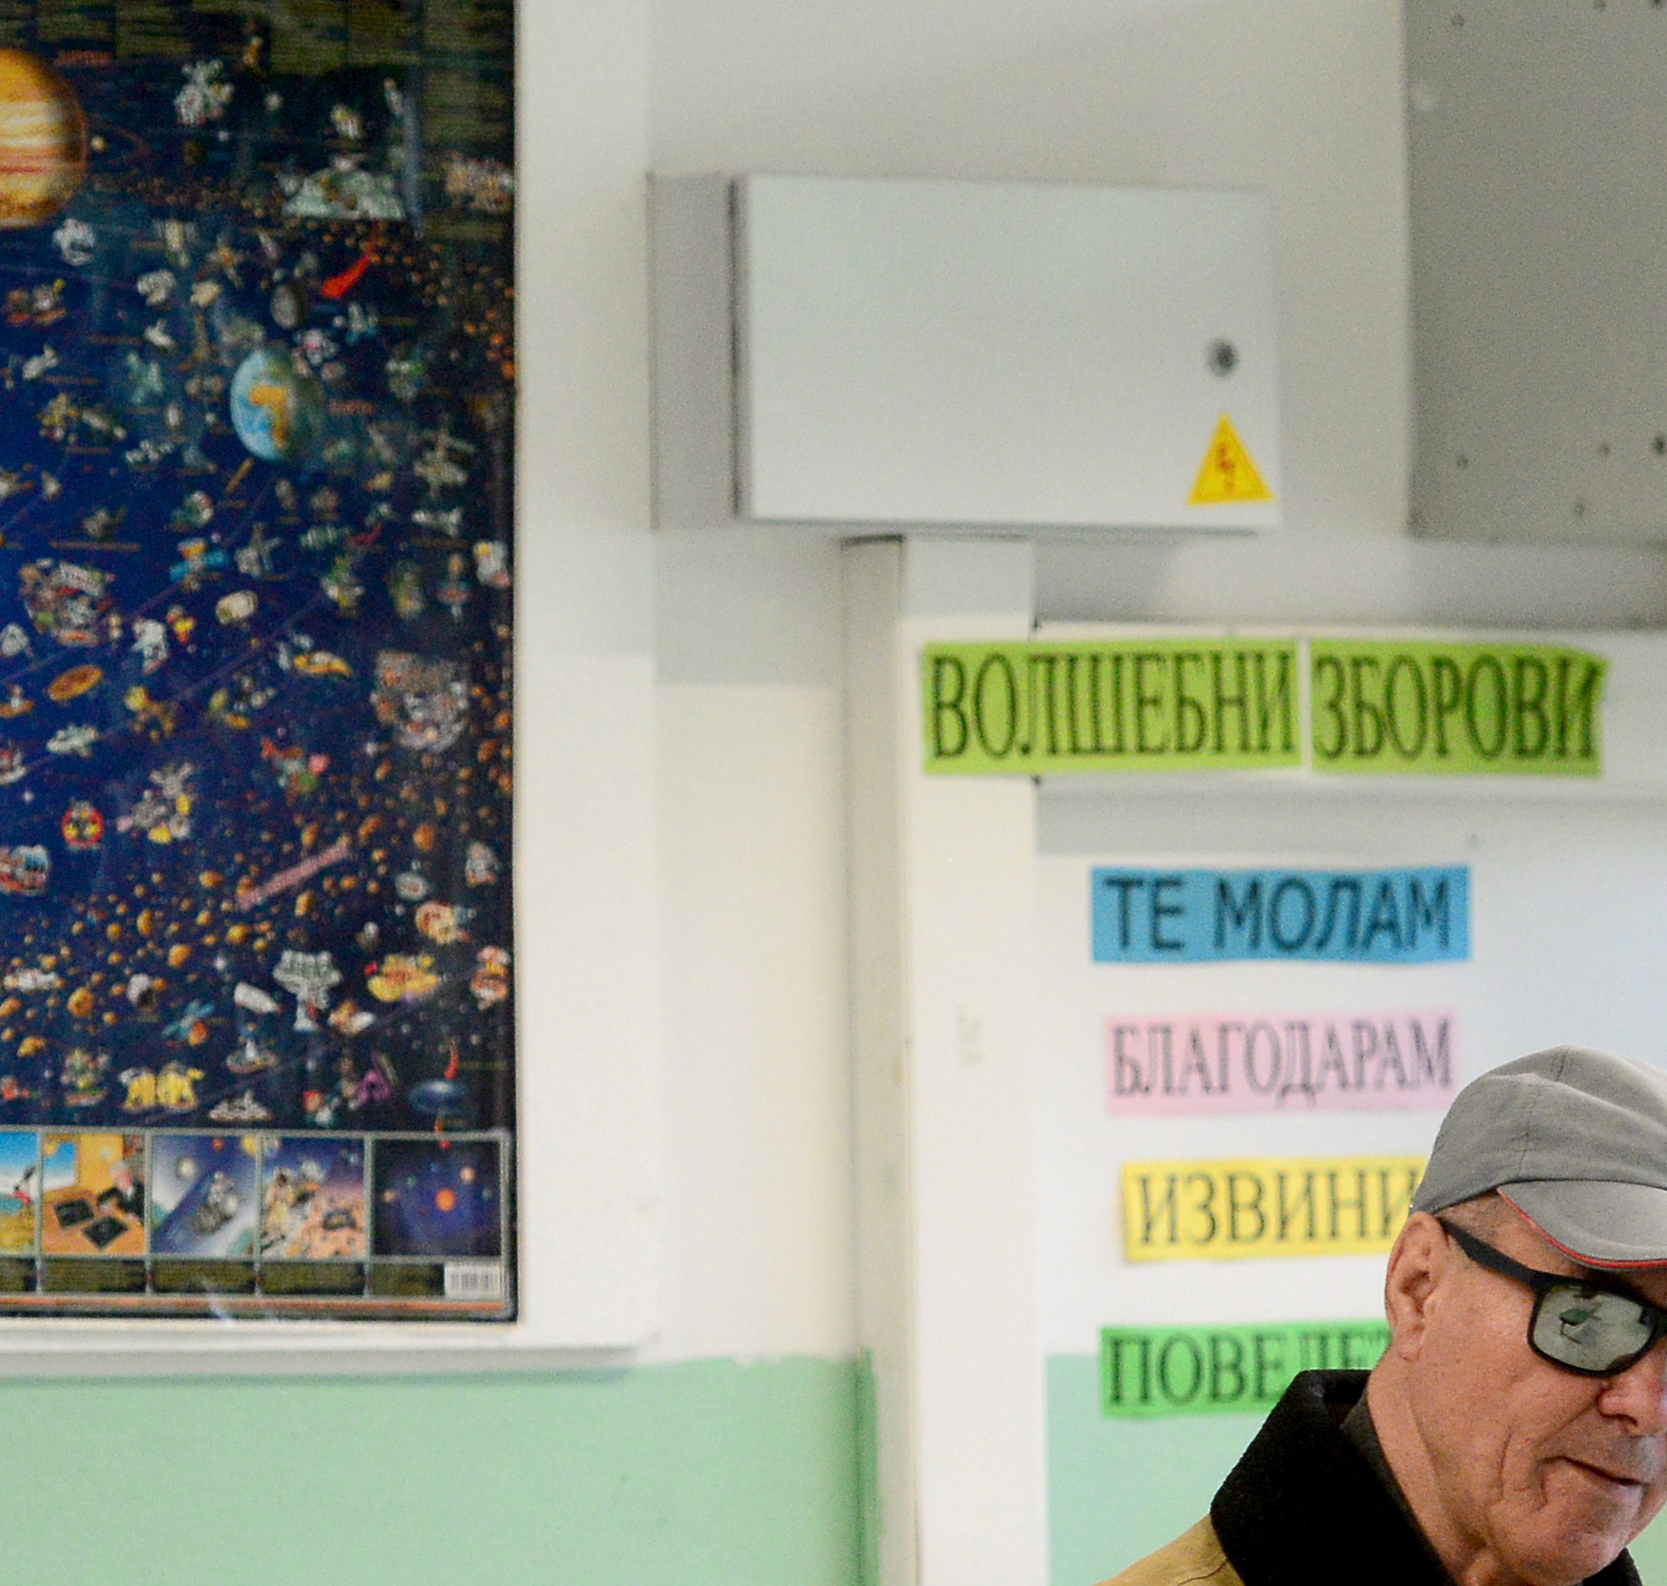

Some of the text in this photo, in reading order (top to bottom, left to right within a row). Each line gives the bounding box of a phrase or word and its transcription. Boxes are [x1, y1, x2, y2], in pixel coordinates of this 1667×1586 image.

[931, 650, 1601, 760] ВОЛШЕБНИ ЗБОРОВИ
[1103, 874, 1452, 951] ТЕ МОЛАМ
[1112, 1017, 1452, 1109] БЛАГОДАРАМ
[1136, 1168, 1421, 1245] ИЗВИНИ
